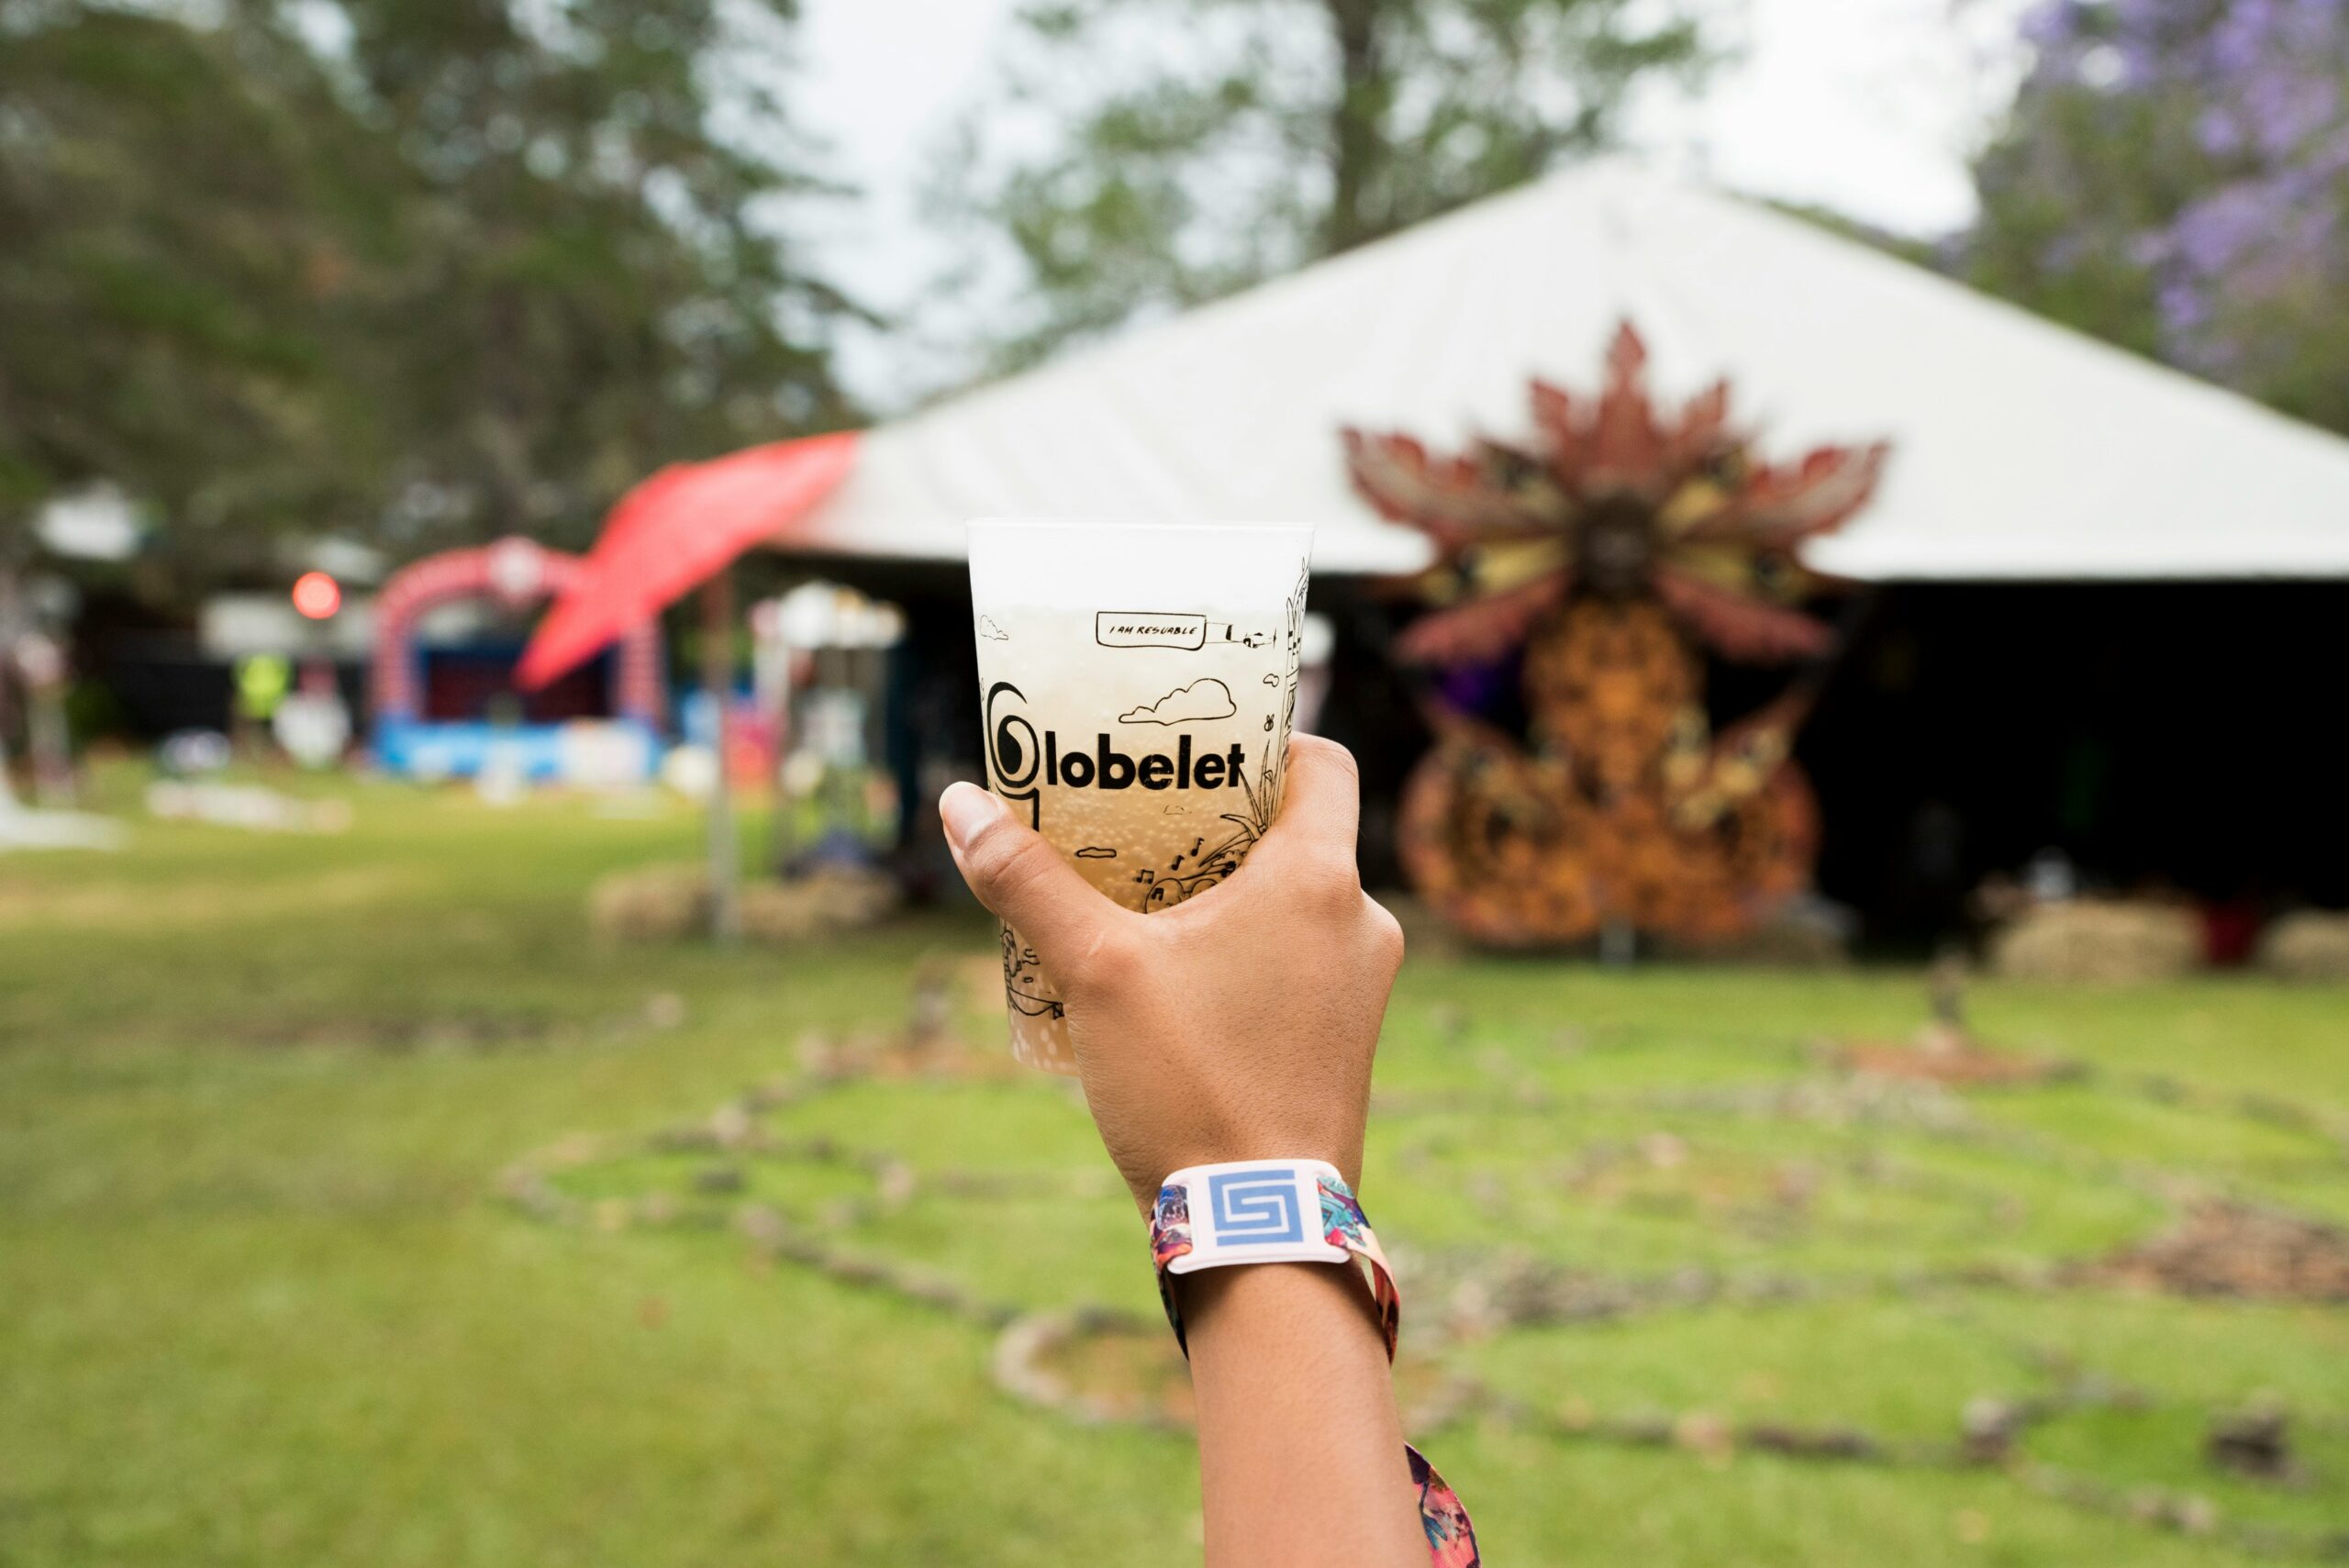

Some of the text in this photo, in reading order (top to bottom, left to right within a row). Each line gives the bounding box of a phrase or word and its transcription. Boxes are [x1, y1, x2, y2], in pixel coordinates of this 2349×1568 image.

[1108, 626, 1197, 636] I AM RESUABLE
